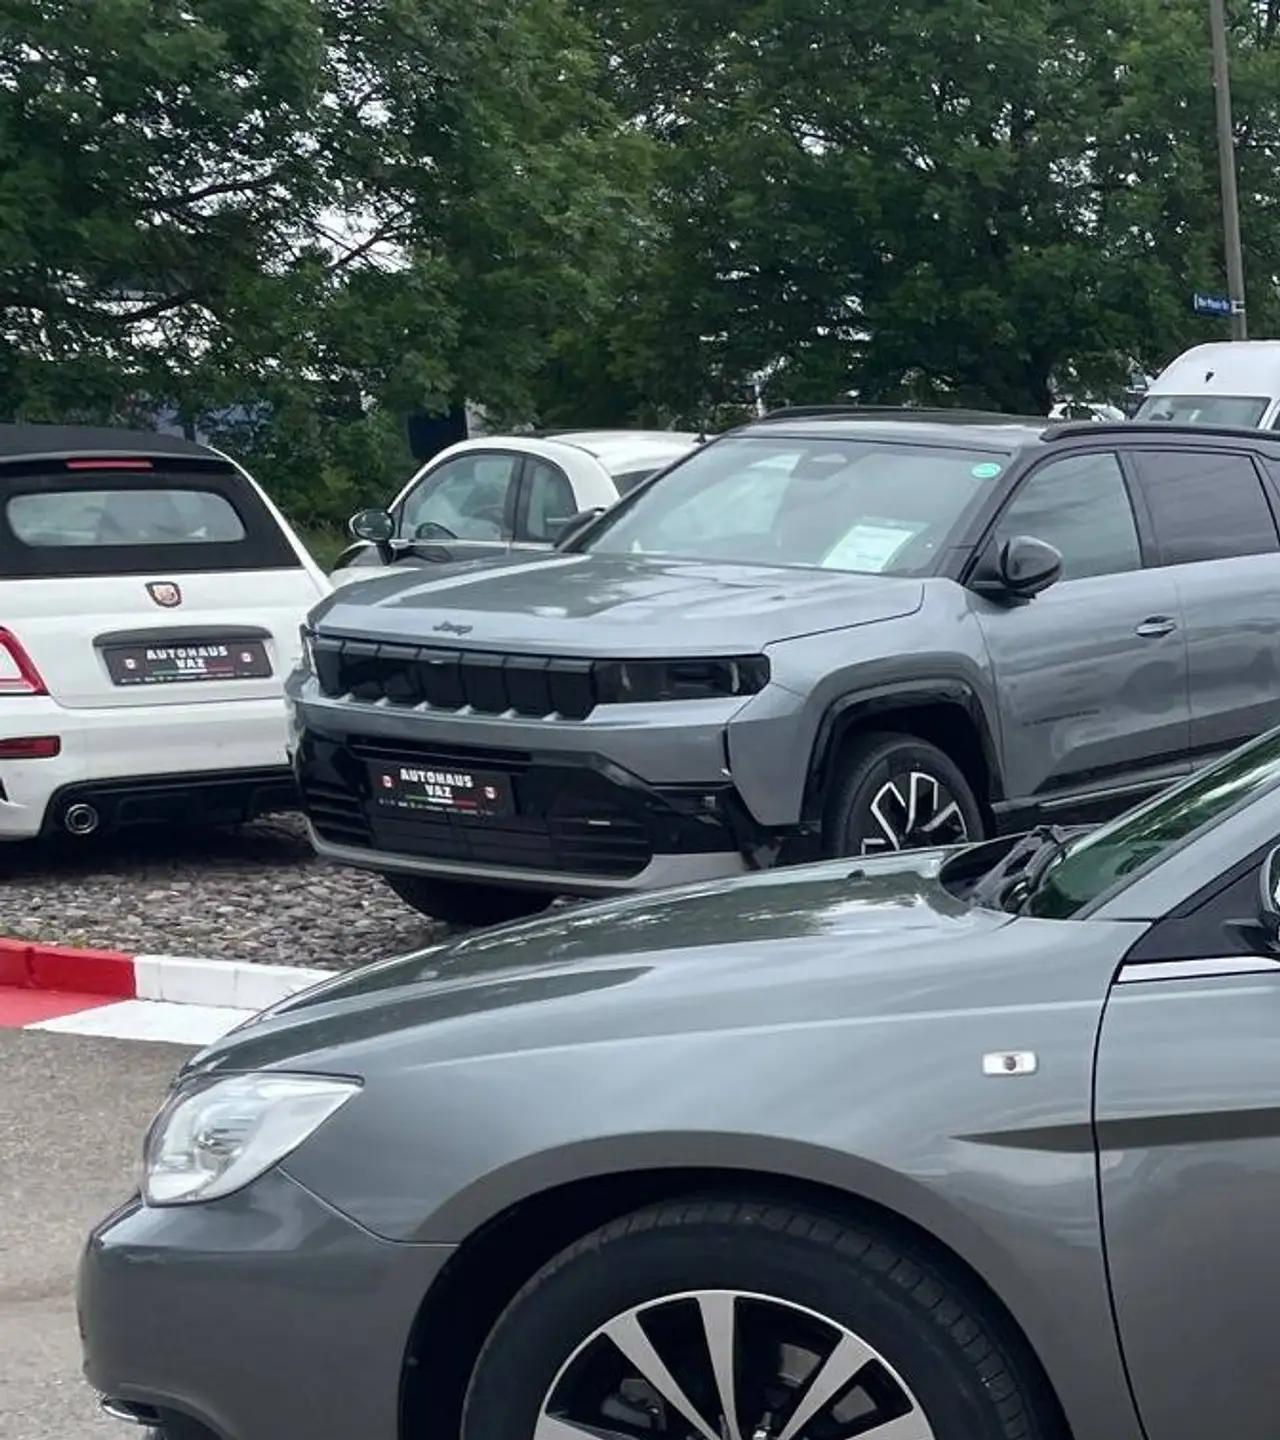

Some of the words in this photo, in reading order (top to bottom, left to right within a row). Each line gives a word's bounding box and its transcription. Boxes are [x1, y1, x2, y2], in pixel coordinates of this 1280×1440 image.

[146, 646, 228, 660] AUTOHAUS
[176, 658, 206, 669] VAZ
[400, 768, 474, 788] AUTOHAUS
[425, 785, 453, 798] VAZ
